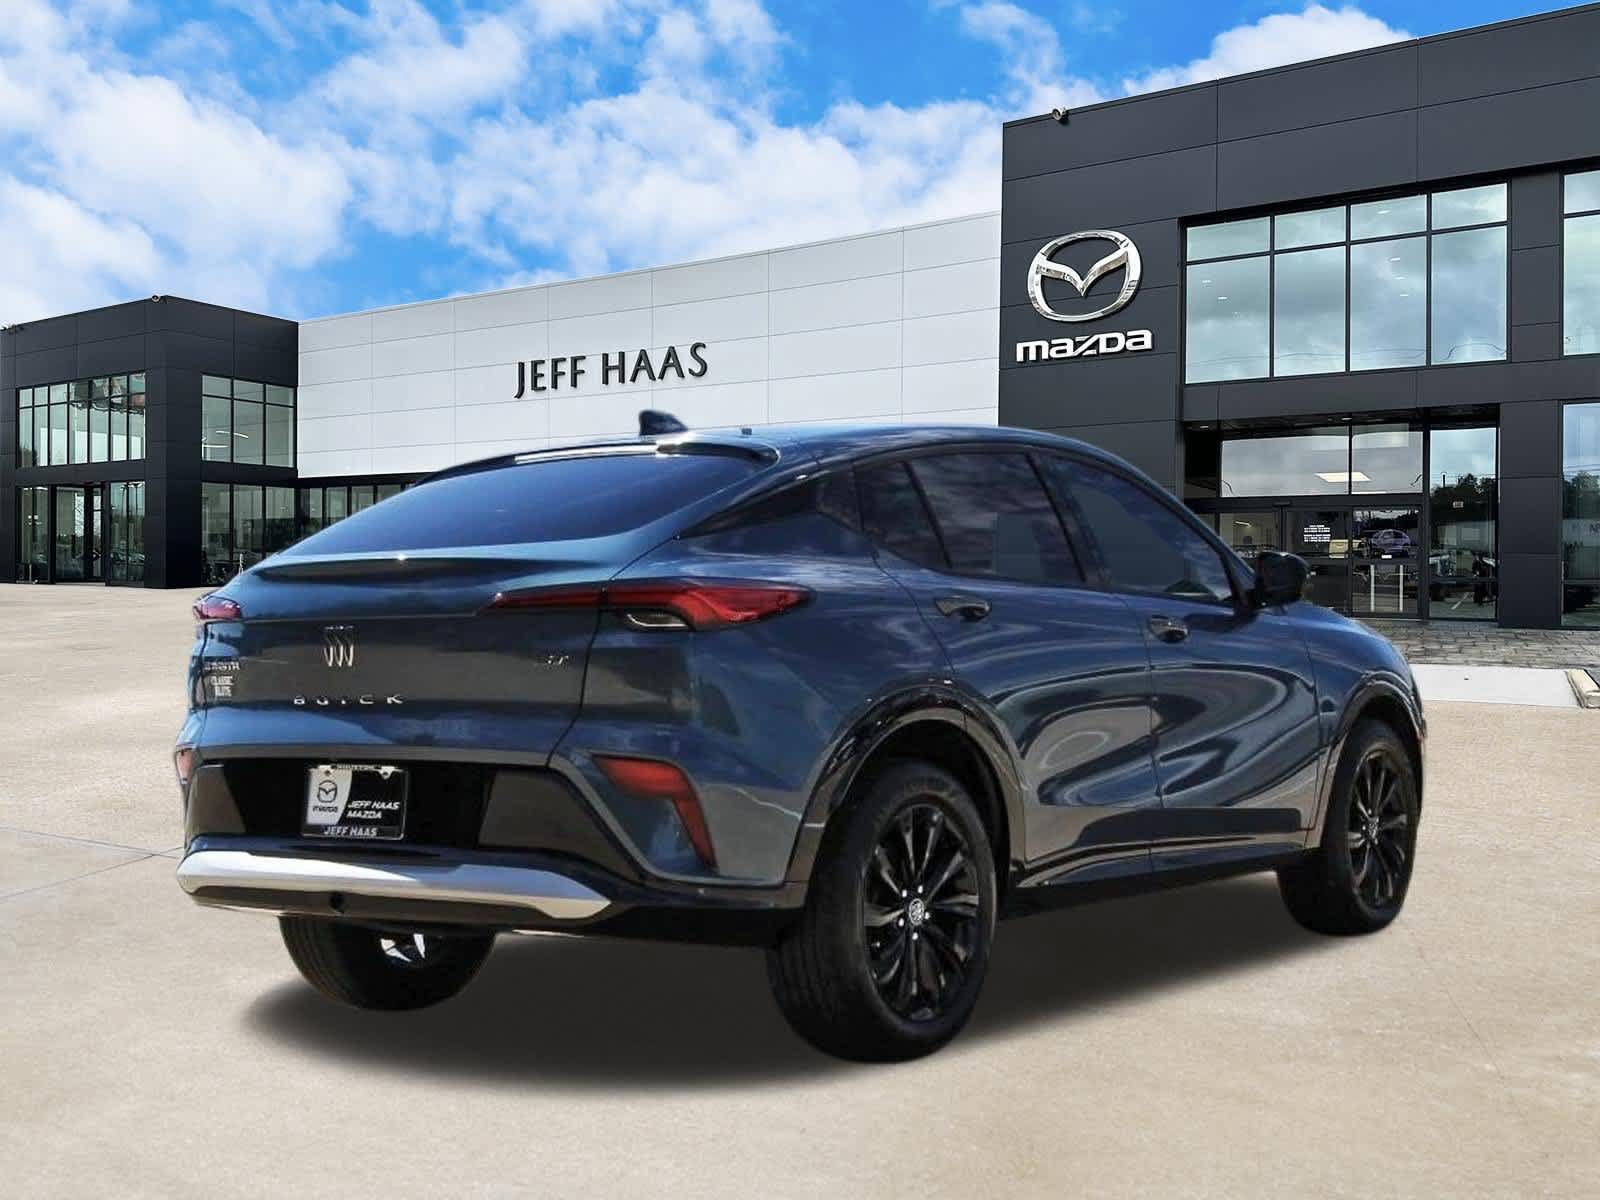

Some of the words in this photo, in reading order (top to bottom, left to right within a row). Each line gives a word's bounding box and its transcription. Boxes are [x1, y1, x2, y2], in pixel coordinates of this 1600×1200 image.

[514, 355, 586, 399] JEFF
[601, 342, 708, 386] HAAS
[293, 694, 403, 706] BUICK
[347, 800, 371, 809] JEFF
[372, 801, 400, 810] HAAS
[346, 810, 382, 819] MAZDA
[323, 825, 348, 835] JEFF
[350, 826, 378, 837] HAAS
